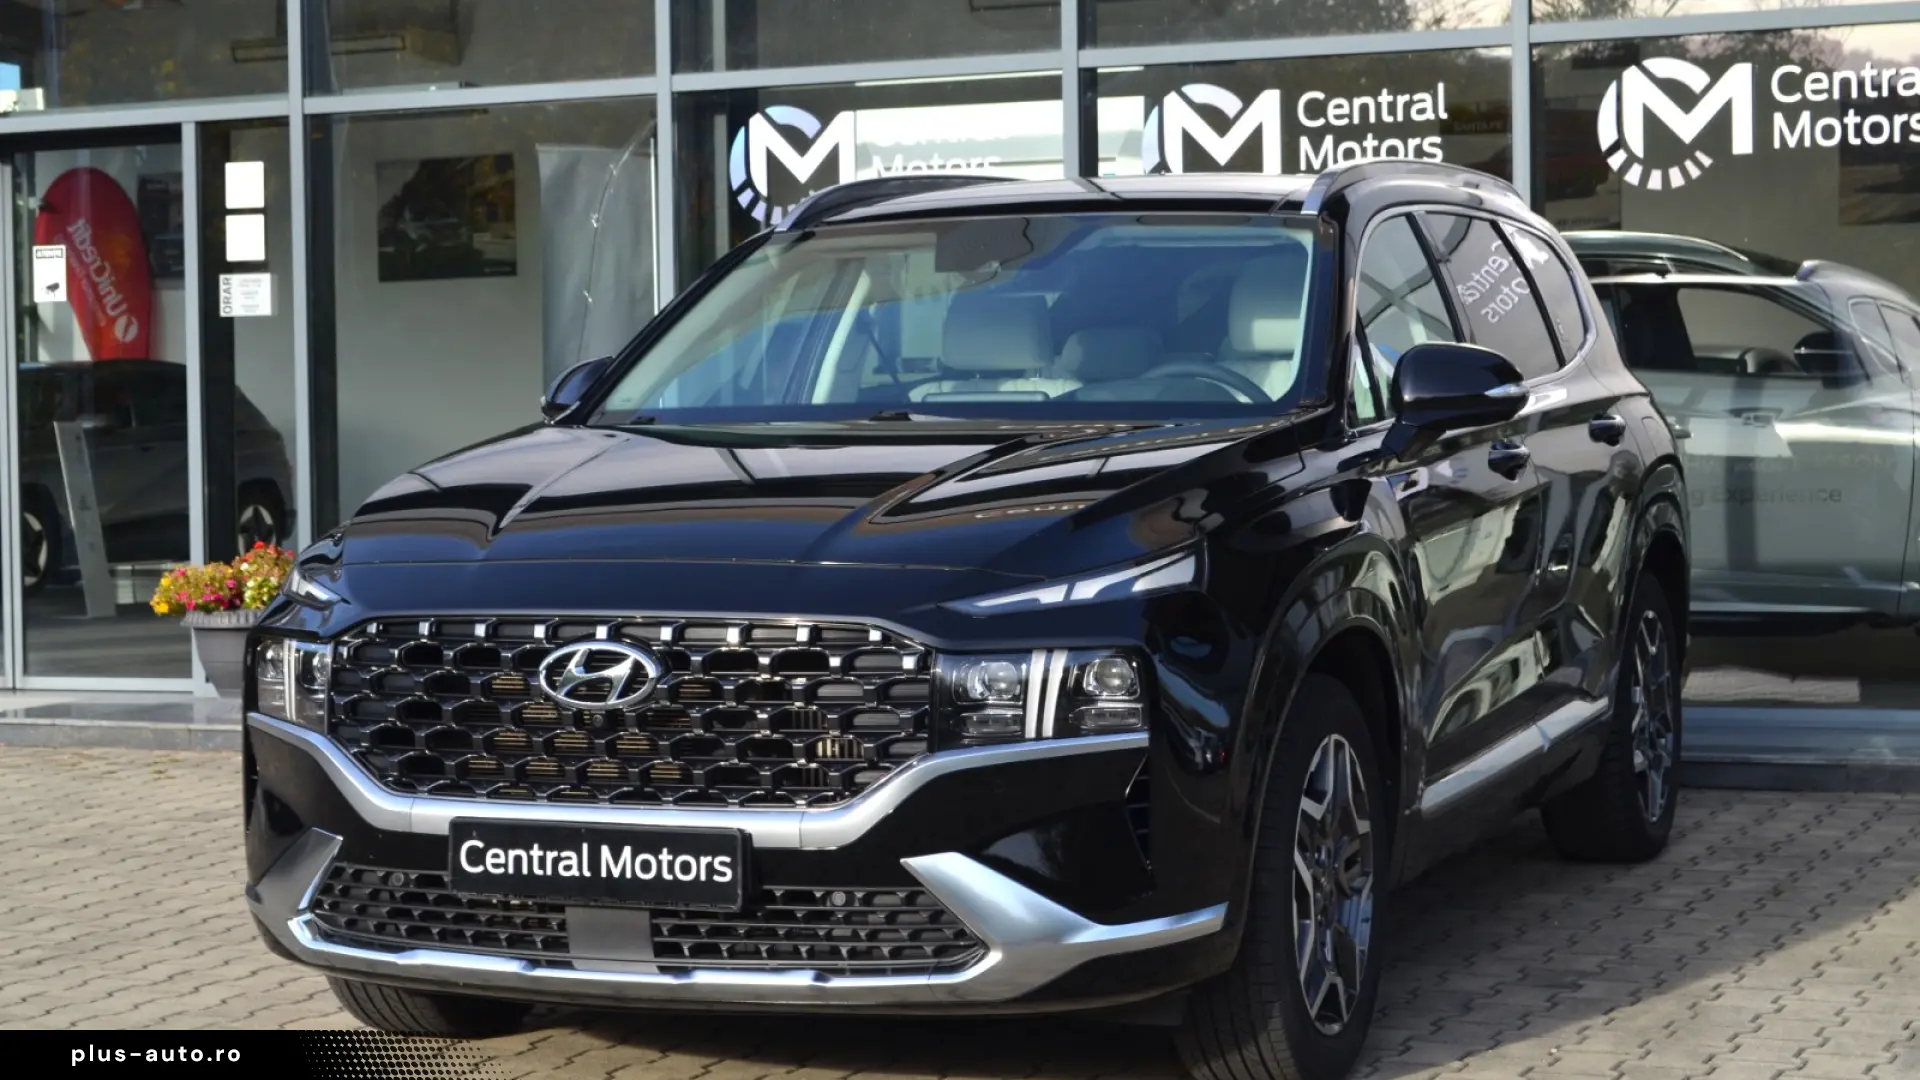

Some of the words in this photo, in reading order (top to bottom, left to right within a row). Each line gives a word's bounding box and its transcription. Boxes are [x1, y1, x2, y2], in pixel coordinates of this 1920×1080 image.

[1771, 61, 1920, 103] Centra
[1297, 82, 1448, 127] Central
[1772, 108, 1920, 149] Motors
[1299, 133, 1443, 171] Motors
[222, 276, 233, 315] ORAR
[459, 839, 592, 877] Central
[600, 844, 733, 883] Motors
